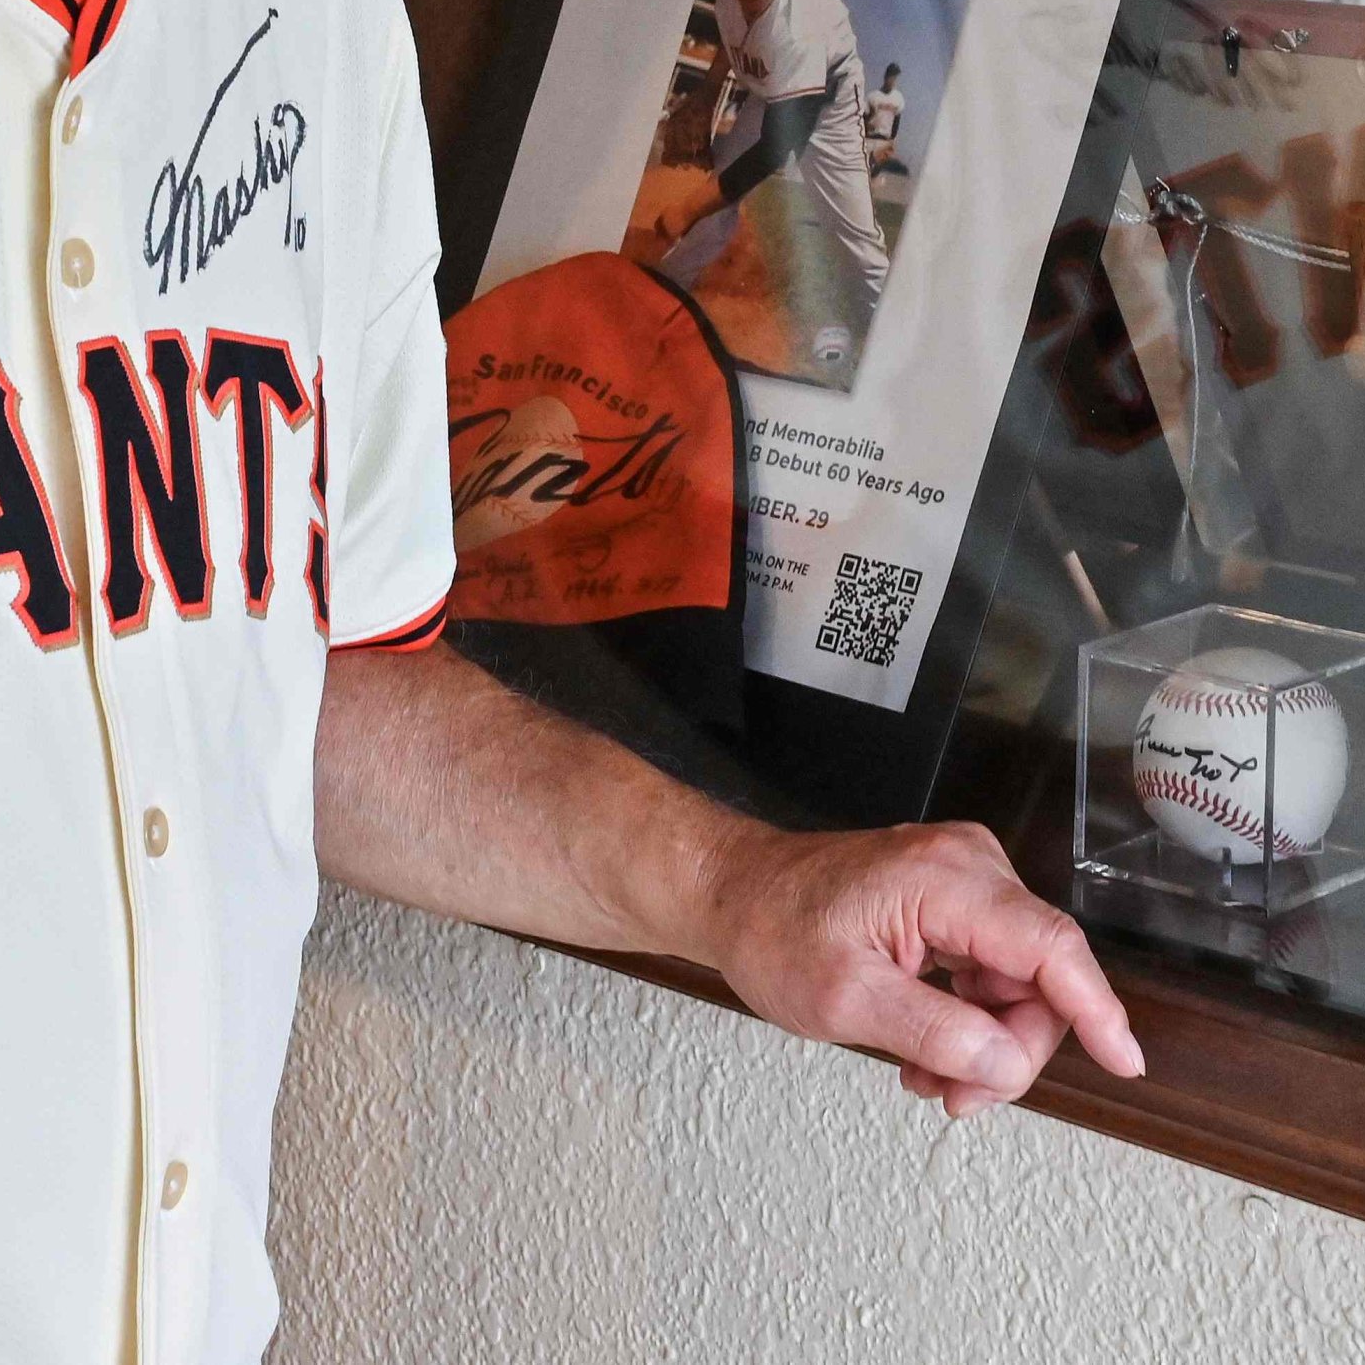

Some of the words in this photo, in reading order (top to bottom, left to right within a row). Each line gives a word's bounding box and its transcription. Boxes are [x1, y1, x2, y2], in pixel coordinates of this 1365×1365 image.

[472, 353, 525, 379] San
[531, 353, 649, 420] Francisco
[744, 418, 769, 436] nd
[772, 423, 885, 462] Memorabilia
[766, 448, 822, 478] Debut
[827, 463, 850, 483] 60
[857, 468, 903, 495] Years
[907, 480, 945, 505] Ago
[805, 508, 829, 529] 29
[765, 554, 784, 571] ON
[788, 559, 810, 576] THE
[763, 575, 771, 588] 2
[771, 577, 794, 594] P.M.
